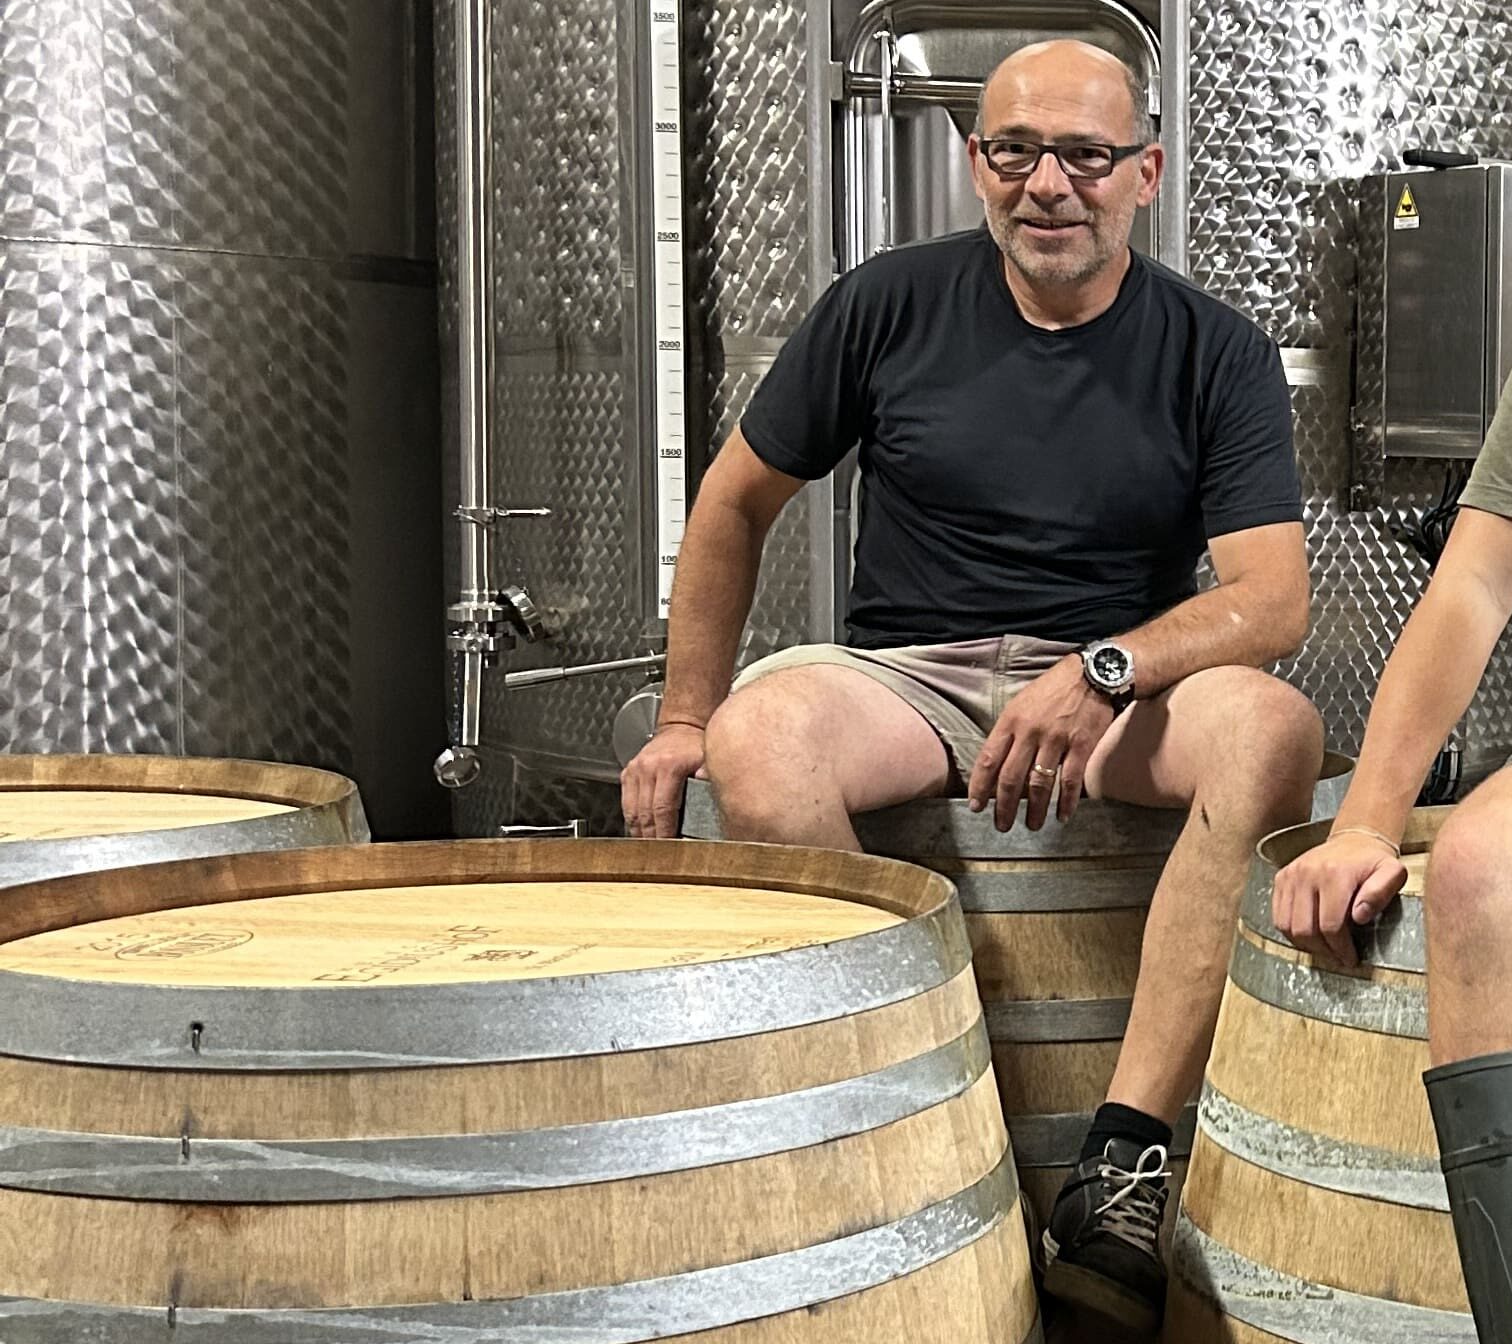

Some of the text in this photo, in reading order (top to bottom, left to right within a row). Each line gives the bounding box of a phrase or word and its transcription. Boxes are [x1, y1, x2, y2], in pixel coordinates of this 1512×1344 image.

[653, 12, 675, 20] 3500
[655, 122, 677, 131] 3000
[657, 232, 680, 240] 2500
[658, 340, 681, 349] 2000
[660, 448, 682, 456] 1500
